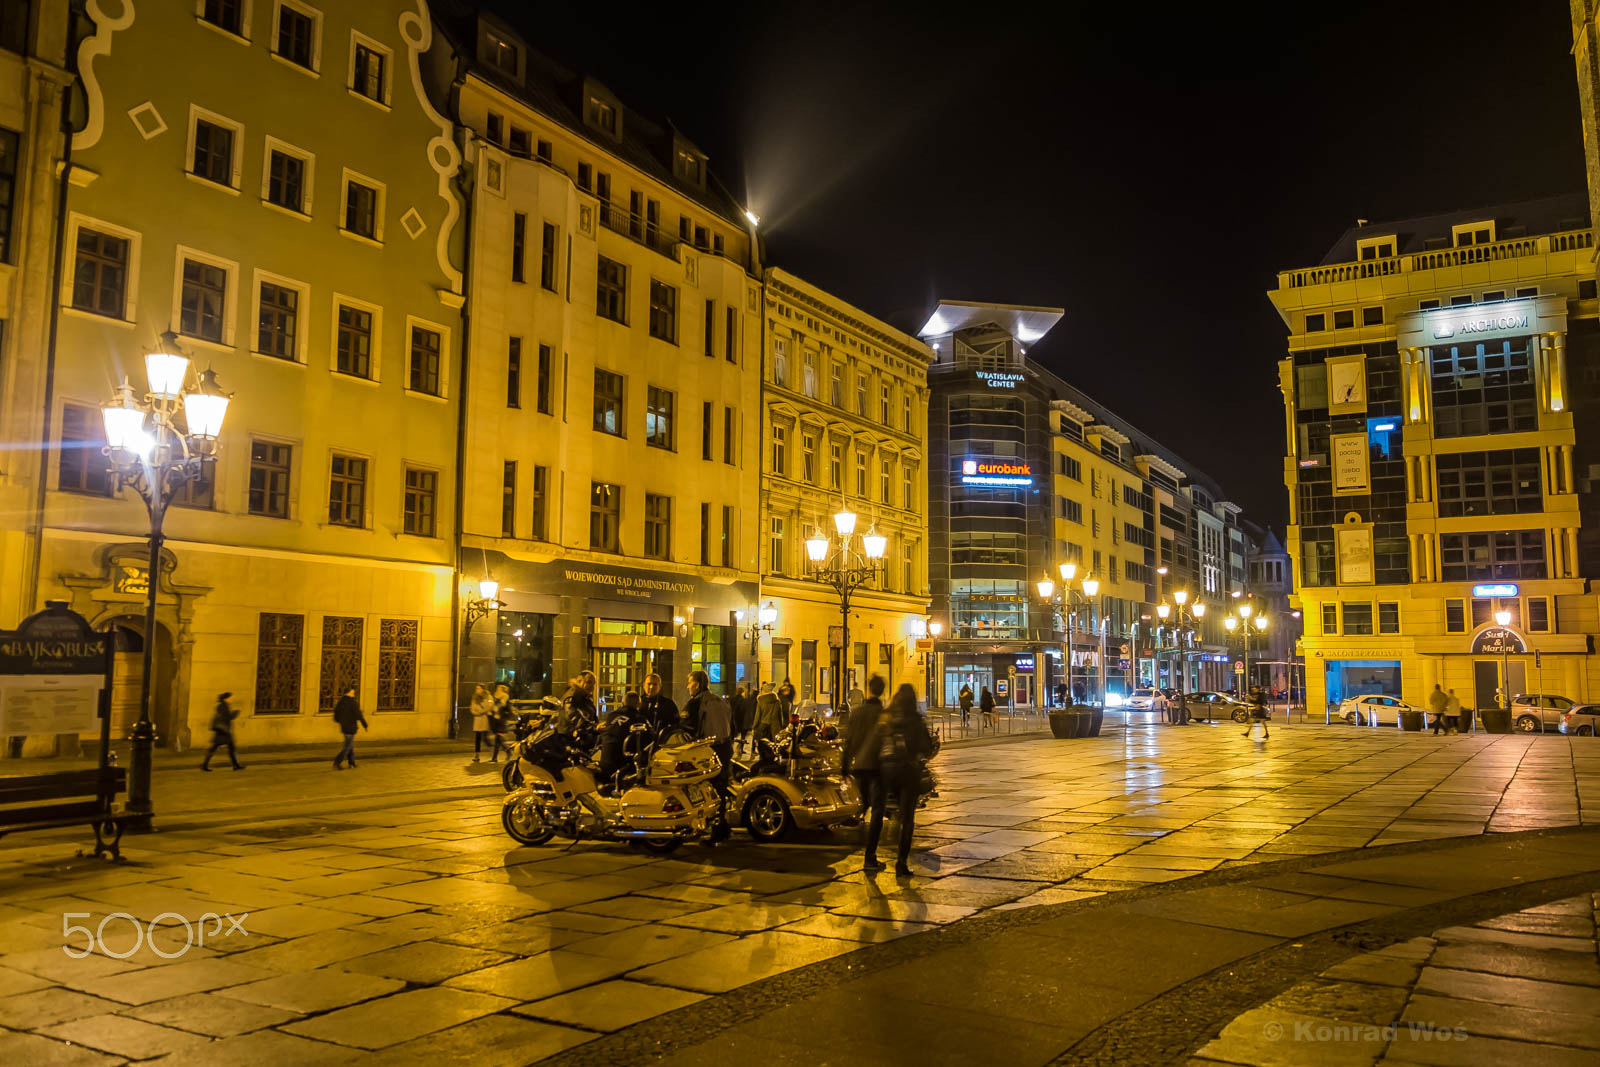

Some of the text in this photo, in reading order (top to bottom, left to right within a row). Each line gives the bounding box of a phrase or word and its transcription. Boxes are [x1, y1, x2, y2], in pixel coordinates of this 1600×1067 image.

[1460, 315, 1529, 335] ARCHICOM
[976, 371, 1025, 382] WRATISLAVIA
[987, 379, 1015, 389] CENTER
[978, 463, 1031, 475] eurobank
[633, 578, 695, 593] ADMINISTRACYJNY
[1482, 645, 1515, 653] Martni
